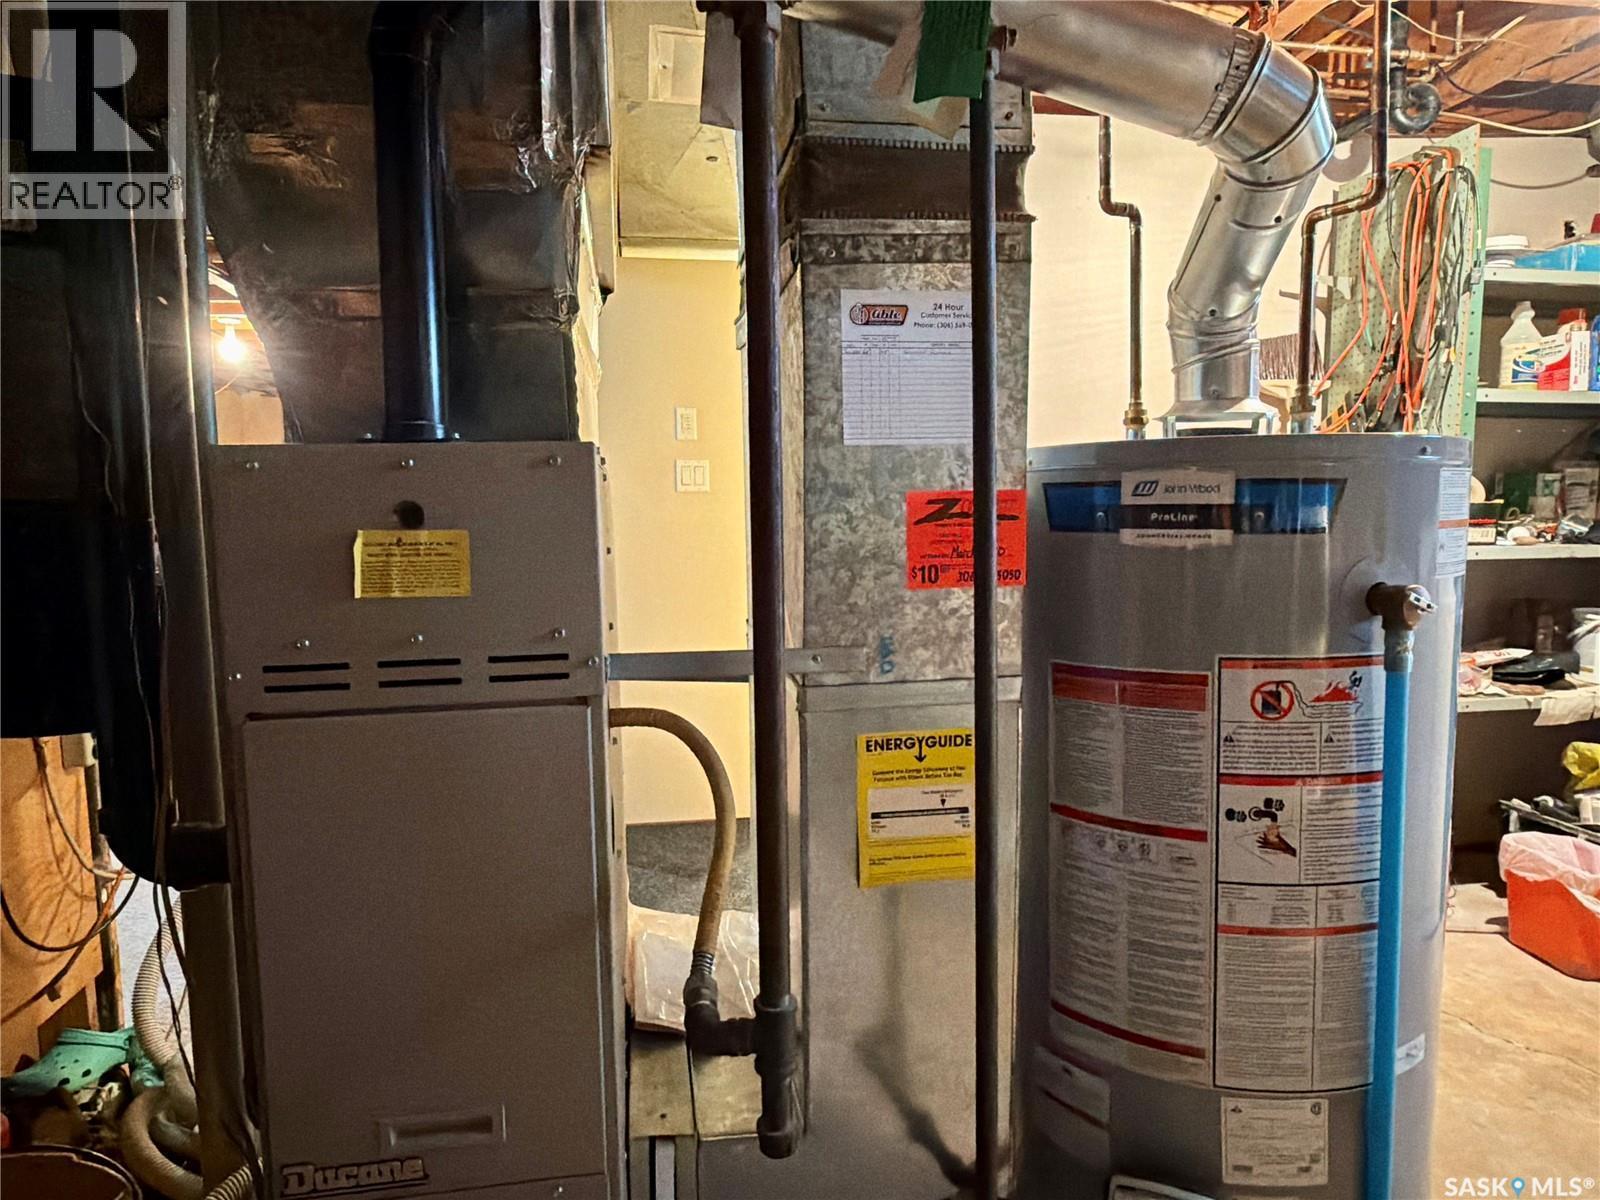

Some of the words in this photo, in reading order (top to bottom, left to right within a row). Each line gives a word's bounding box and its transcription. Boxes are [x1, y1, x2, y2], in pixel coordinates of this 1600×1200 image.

[933, 303, 943, 311] 24
[945, 303, 964, 311] Hour
[1164, 485, 1187, 493] John
[1189, 485, 1220, 493] Wood
[911, 563, 940, 585] $10
[865, 734, 973, 755] ENERGYGUIDE
[280, 1157, 427, 1197] Ducane
